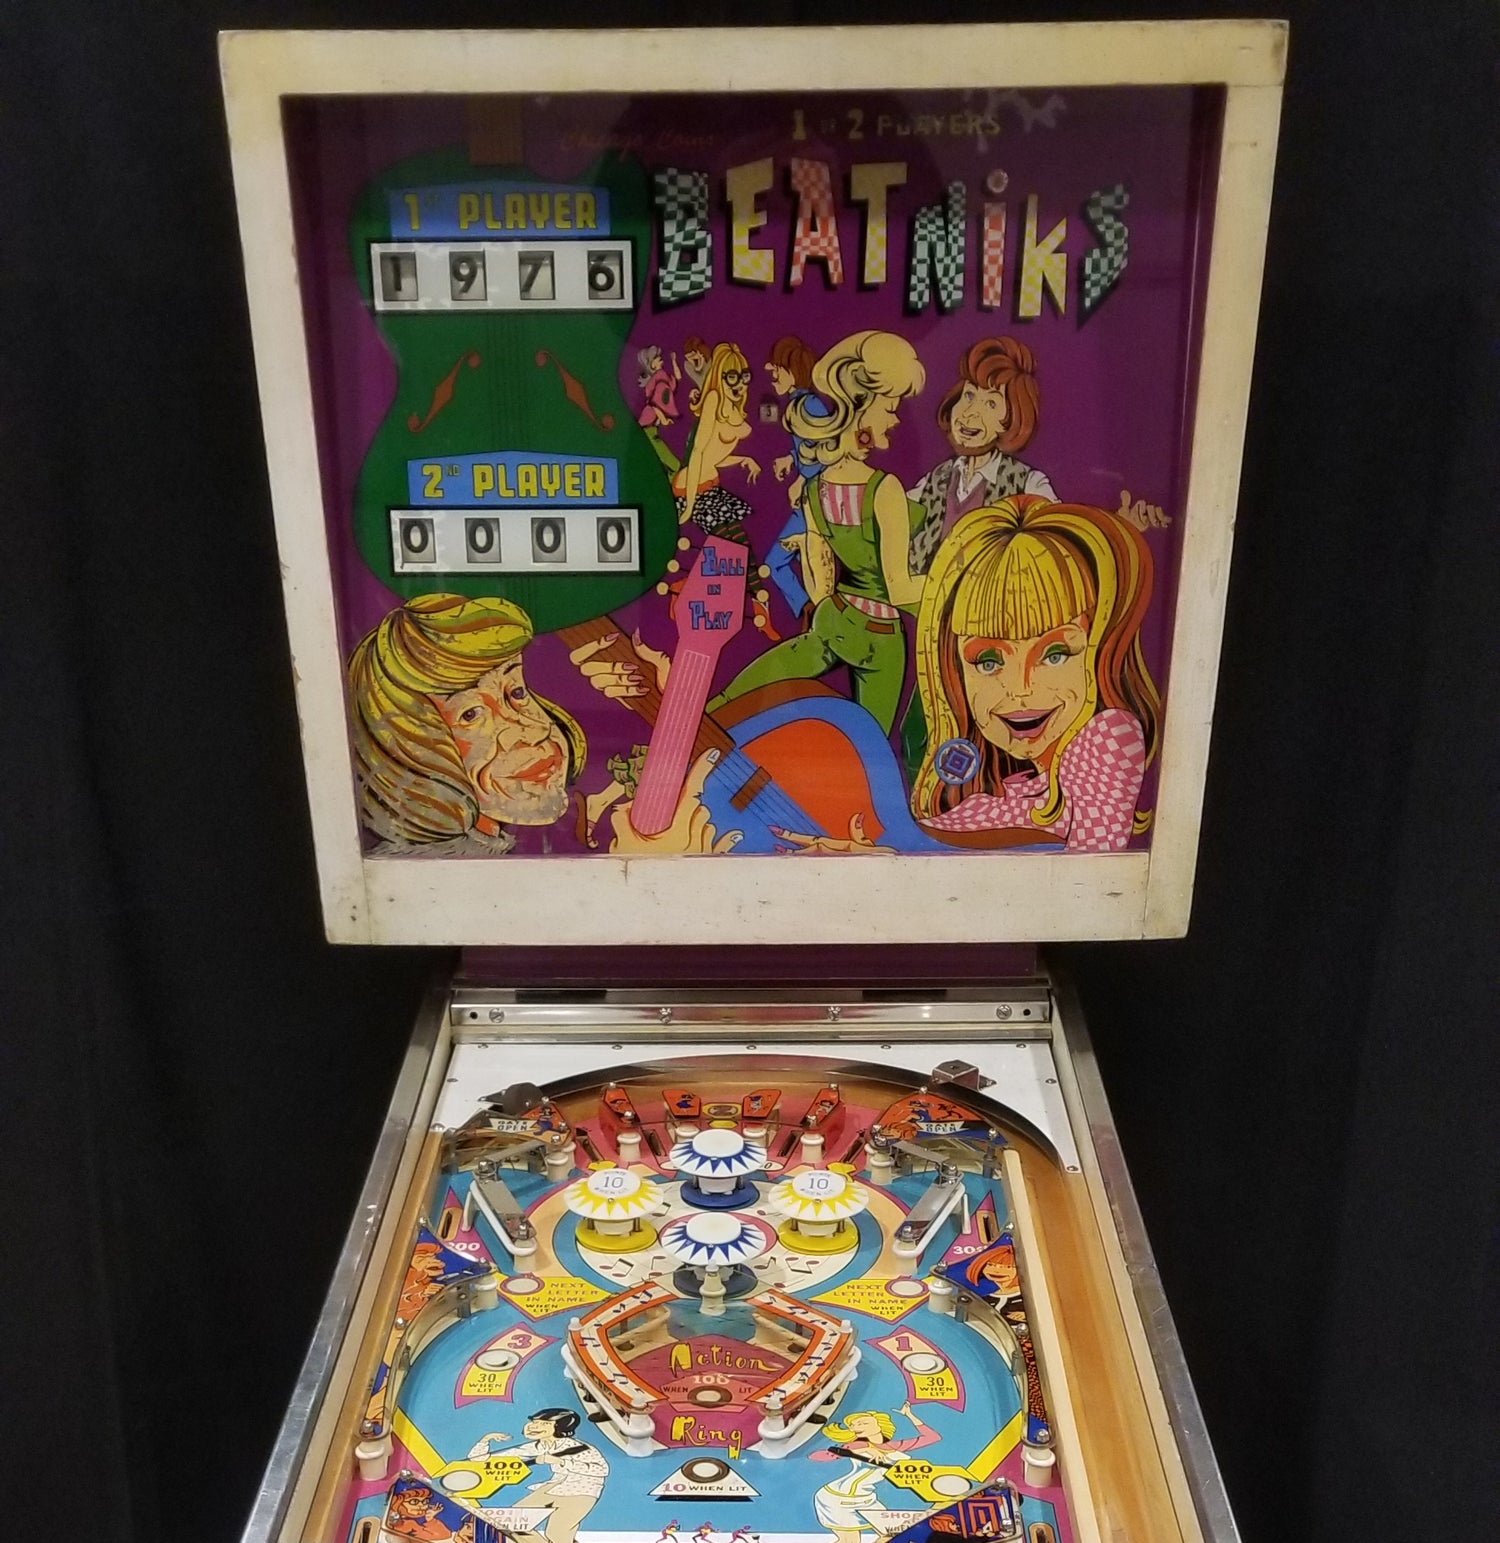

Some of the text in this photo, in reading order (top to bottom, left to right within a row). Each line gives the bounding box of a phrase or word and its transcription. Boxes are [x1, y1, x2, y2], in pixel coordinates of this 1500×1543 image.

[792, 109, 806, 140] 1
[848, 108, 864, 139] 2
[877, 113, 1001, 136] PLAYERS
[457, 193, 598, 230] PLAYER
[472, 463, 606, 498] PLAYER
[700, 545, 744, 577] BALL
[708, 584, 721, 596] IN
[688, 600, 733, 631] PLAY
[604, 1176, 624, 1188] 10
[809, 1177, 829, 1190] 10
[506, 1333, 533, 1349] 3
[896, 1336, 913, 1351] 1
[670, 1343, 781, 1377] Action
[476, 1372, 497, 1384] 30
[692, 1373, 730, 1385] 100
[926, 1376, 945, 1388] 30
[671, 1416, 742, 1460] Ring
[483, 1461, 523, 1470] 100
[894, 1464, 933, 1474] 100
[662, 1483, 687, 1492] 10
